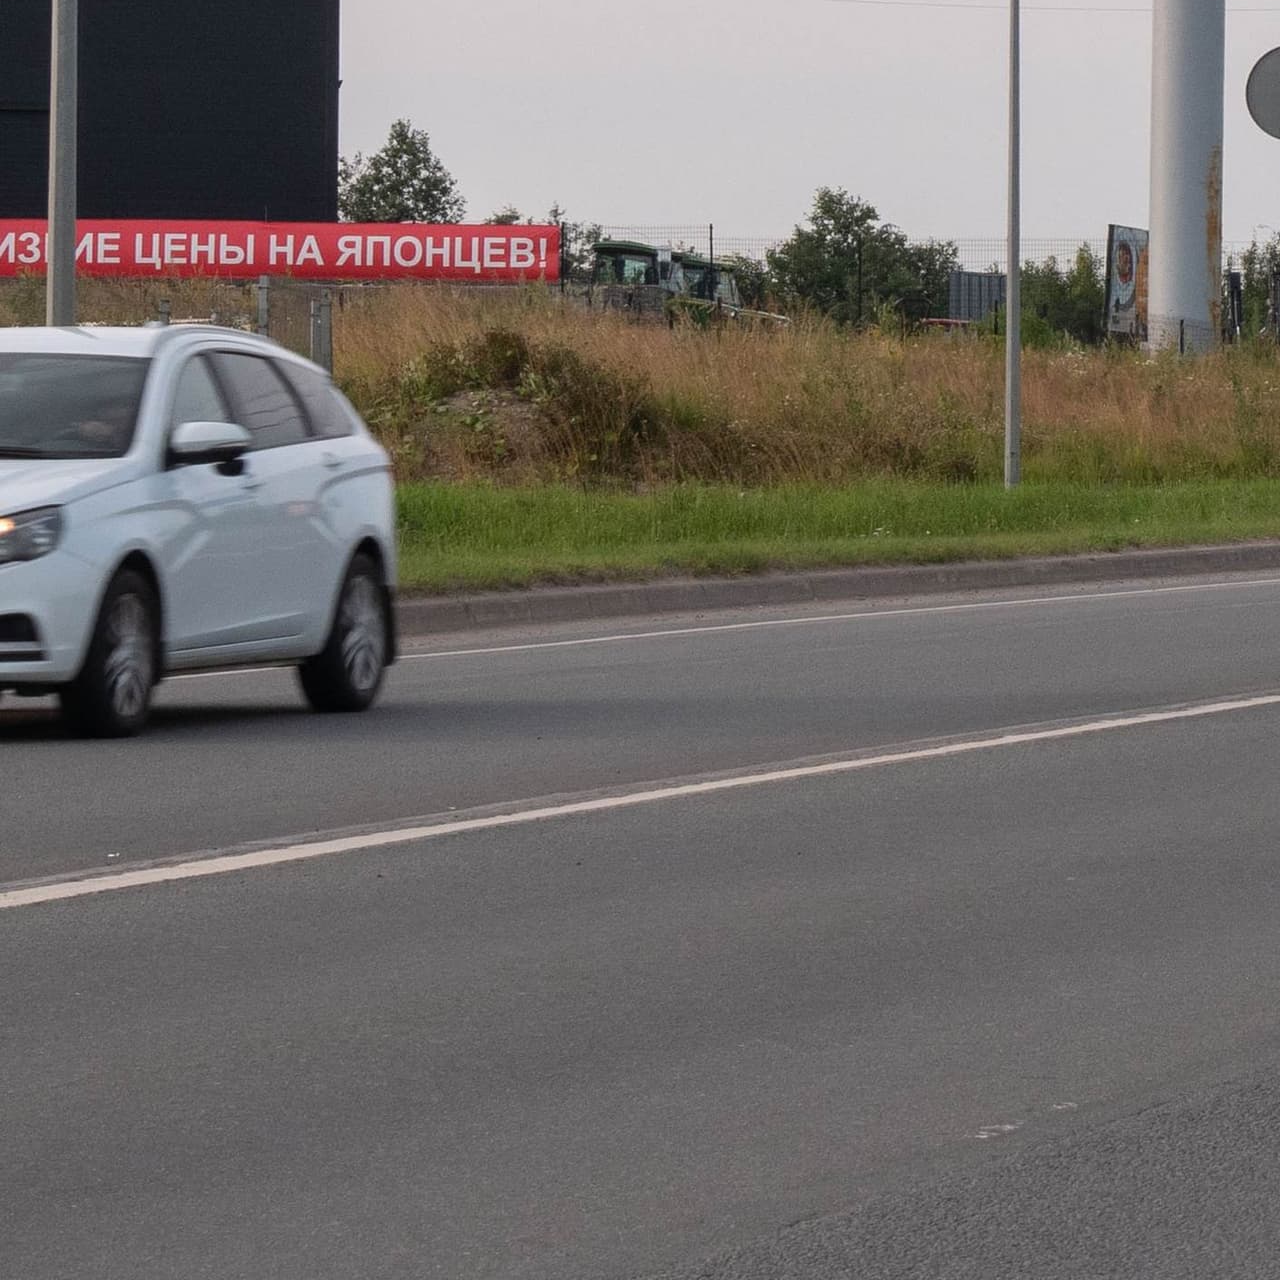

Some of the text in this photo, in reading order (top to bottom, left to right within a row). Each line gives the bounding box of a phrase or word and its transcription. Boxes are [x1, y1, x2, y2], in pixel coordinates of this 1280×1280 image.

[0, 232, 548, 273] ИЗИЕ ЦЕНЫ НА ЯПОНЦЕВ!
